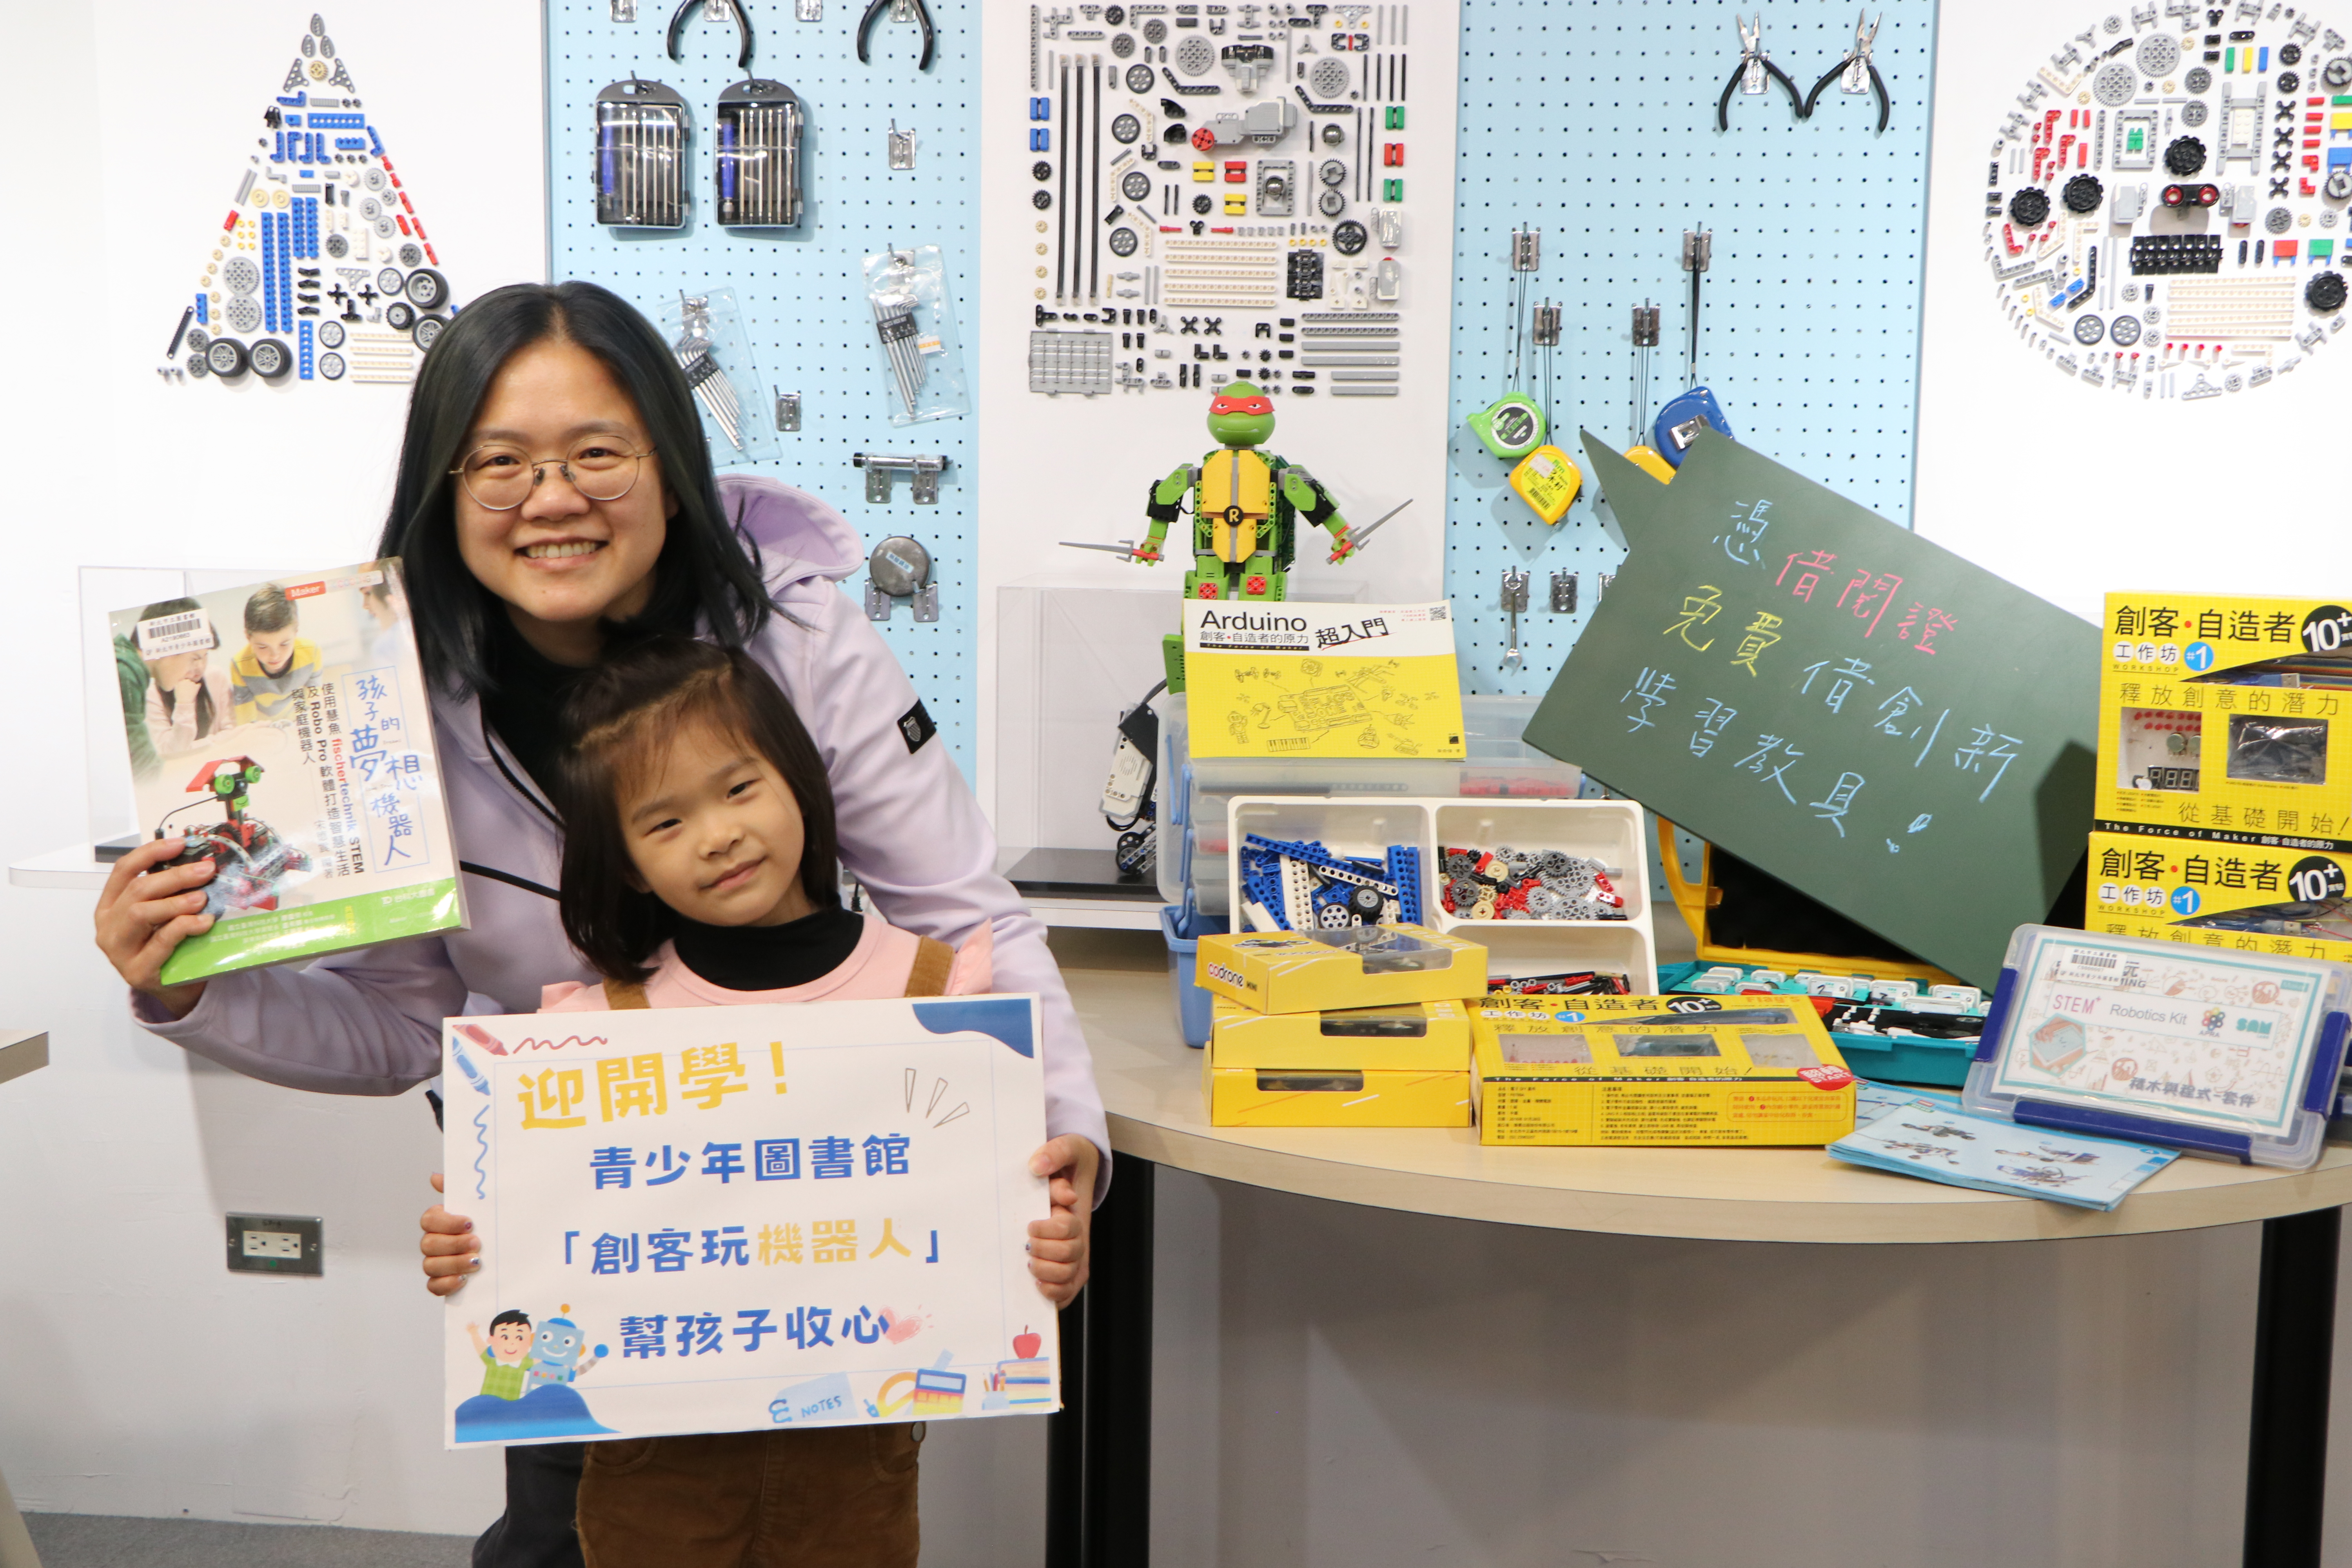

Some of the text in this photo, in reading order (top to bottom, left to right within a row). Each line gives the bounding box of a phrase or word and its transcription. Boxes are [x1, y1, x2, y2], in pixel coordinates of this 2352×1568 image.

[1229, 510, 1239, 523] R
[291, 585, 321, 598] Maker
[1200, 610, 1307, 632] Arduino
[1315, 617, 1389, 649] 超入門
[2116, 644, 2178, 662] 工作坊
[2186, 645, 2208, 669] #1
[2113, 664, 2179, 673] WORKSHOP
[307, 686, 320, 699] 及
[2119, 682, 2339, 717] 釋放創意的潛力
[310, 701, 323, 735] Robo
[317, 739, 327, 762] Pro
[321, 682, 365, 874] 使用慧魚 fischertechnik STEM
[349, 675, 423, 866] 孩子的夢想機器人
[2178, 802, 2350, 836] 從基礎開始!
[2105, 822, 2129, 832] The
[2138, 825, 2179, 837] Force
[2189, 829, 2203, 838] of
[2212, 831, 2256, 842] Maker
[2289, 864, 2339, 902] 10+
[2101, 886, 2164, 905] 工作坊
[2173, 890, 2194, 914] #1
[2098, 905, 2165, 915] WORKSHOP
[1208, 963, 1258, 991] codrone MINI
[1485, 1010, 1548, 1019] 工作坊
[2109, 1004, 2166, 1022] Robotics
[2169, 1012, 2188, 1025] Kit
[1494, 1024, 1718, 1034] 釋放創意的潛力
[1810, 1072, 1851, 1083] START
[590, 1132, 911, 1189] 青少年圖書館
[619, 1305, 891, 1360] 幫孩子收心
[801, 1395, 842, 1419] NOTES
